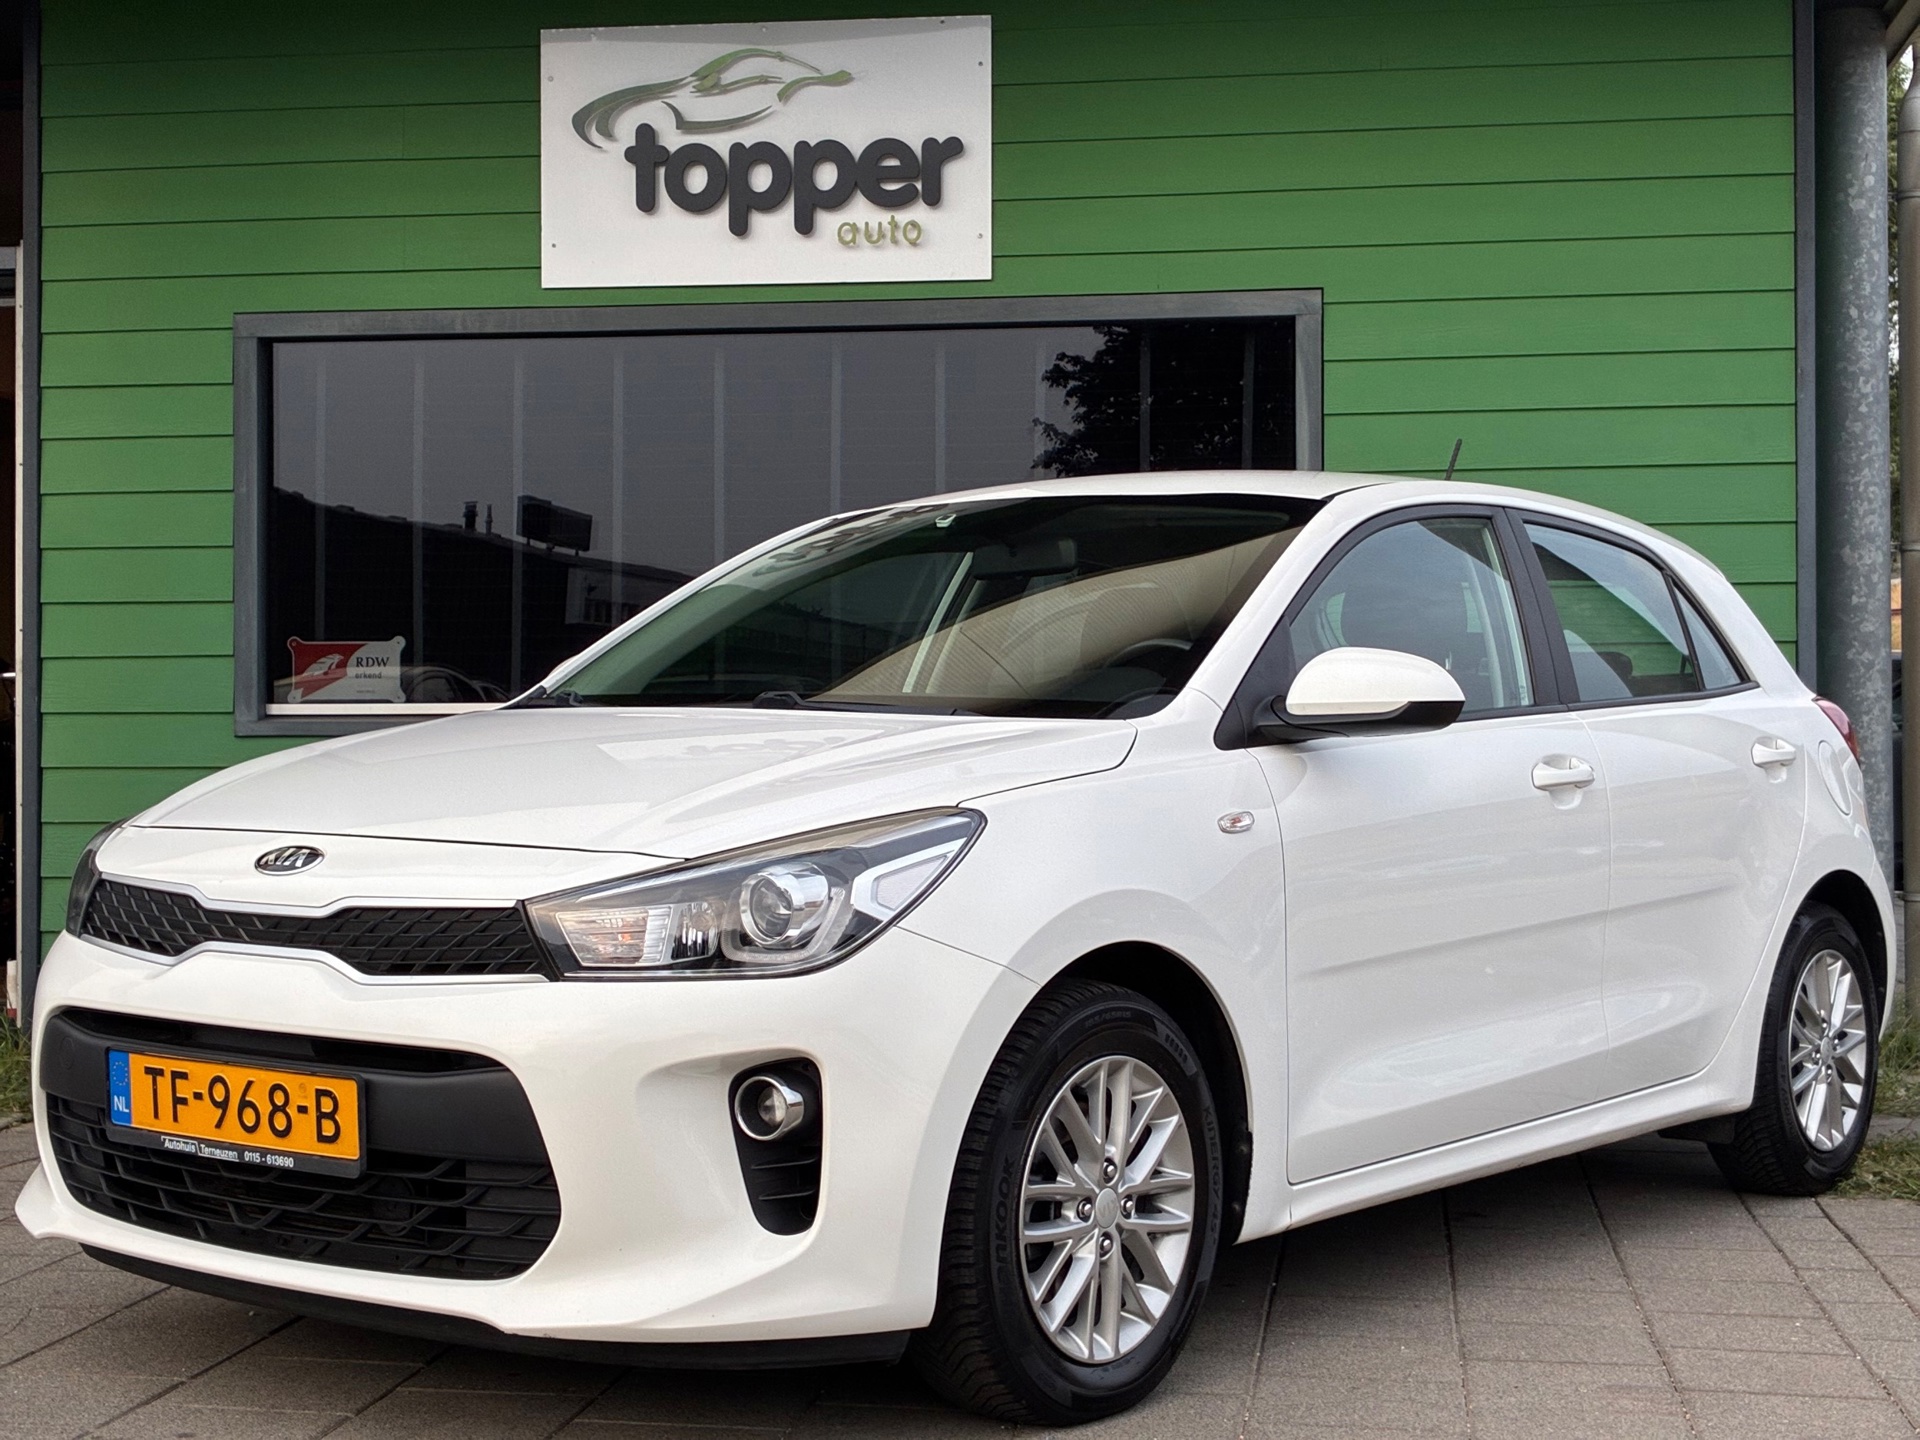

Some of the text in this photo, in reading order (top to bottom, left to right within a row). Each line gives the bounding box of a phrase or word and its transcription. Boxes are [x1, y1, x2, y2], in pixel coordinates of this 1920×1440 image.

[623, 122, 964, 237] topper
[836, 214, 922, 247] auto
[355, 656, 390, 668] RDW
[355, 671, 382, 679] erkend
[259, 847, 310, 867] KIA
[113, 1095, 130, 1113] NL
[143, 1065, 341, 1145] TF-968-B
[164, 1138, 196, 1153] Autohuis
[200, 1144, 238, 1160] Terneuzen
[244, 1150, 260, 1163] 0115
[266, 1154, 294, 1168] 613690
